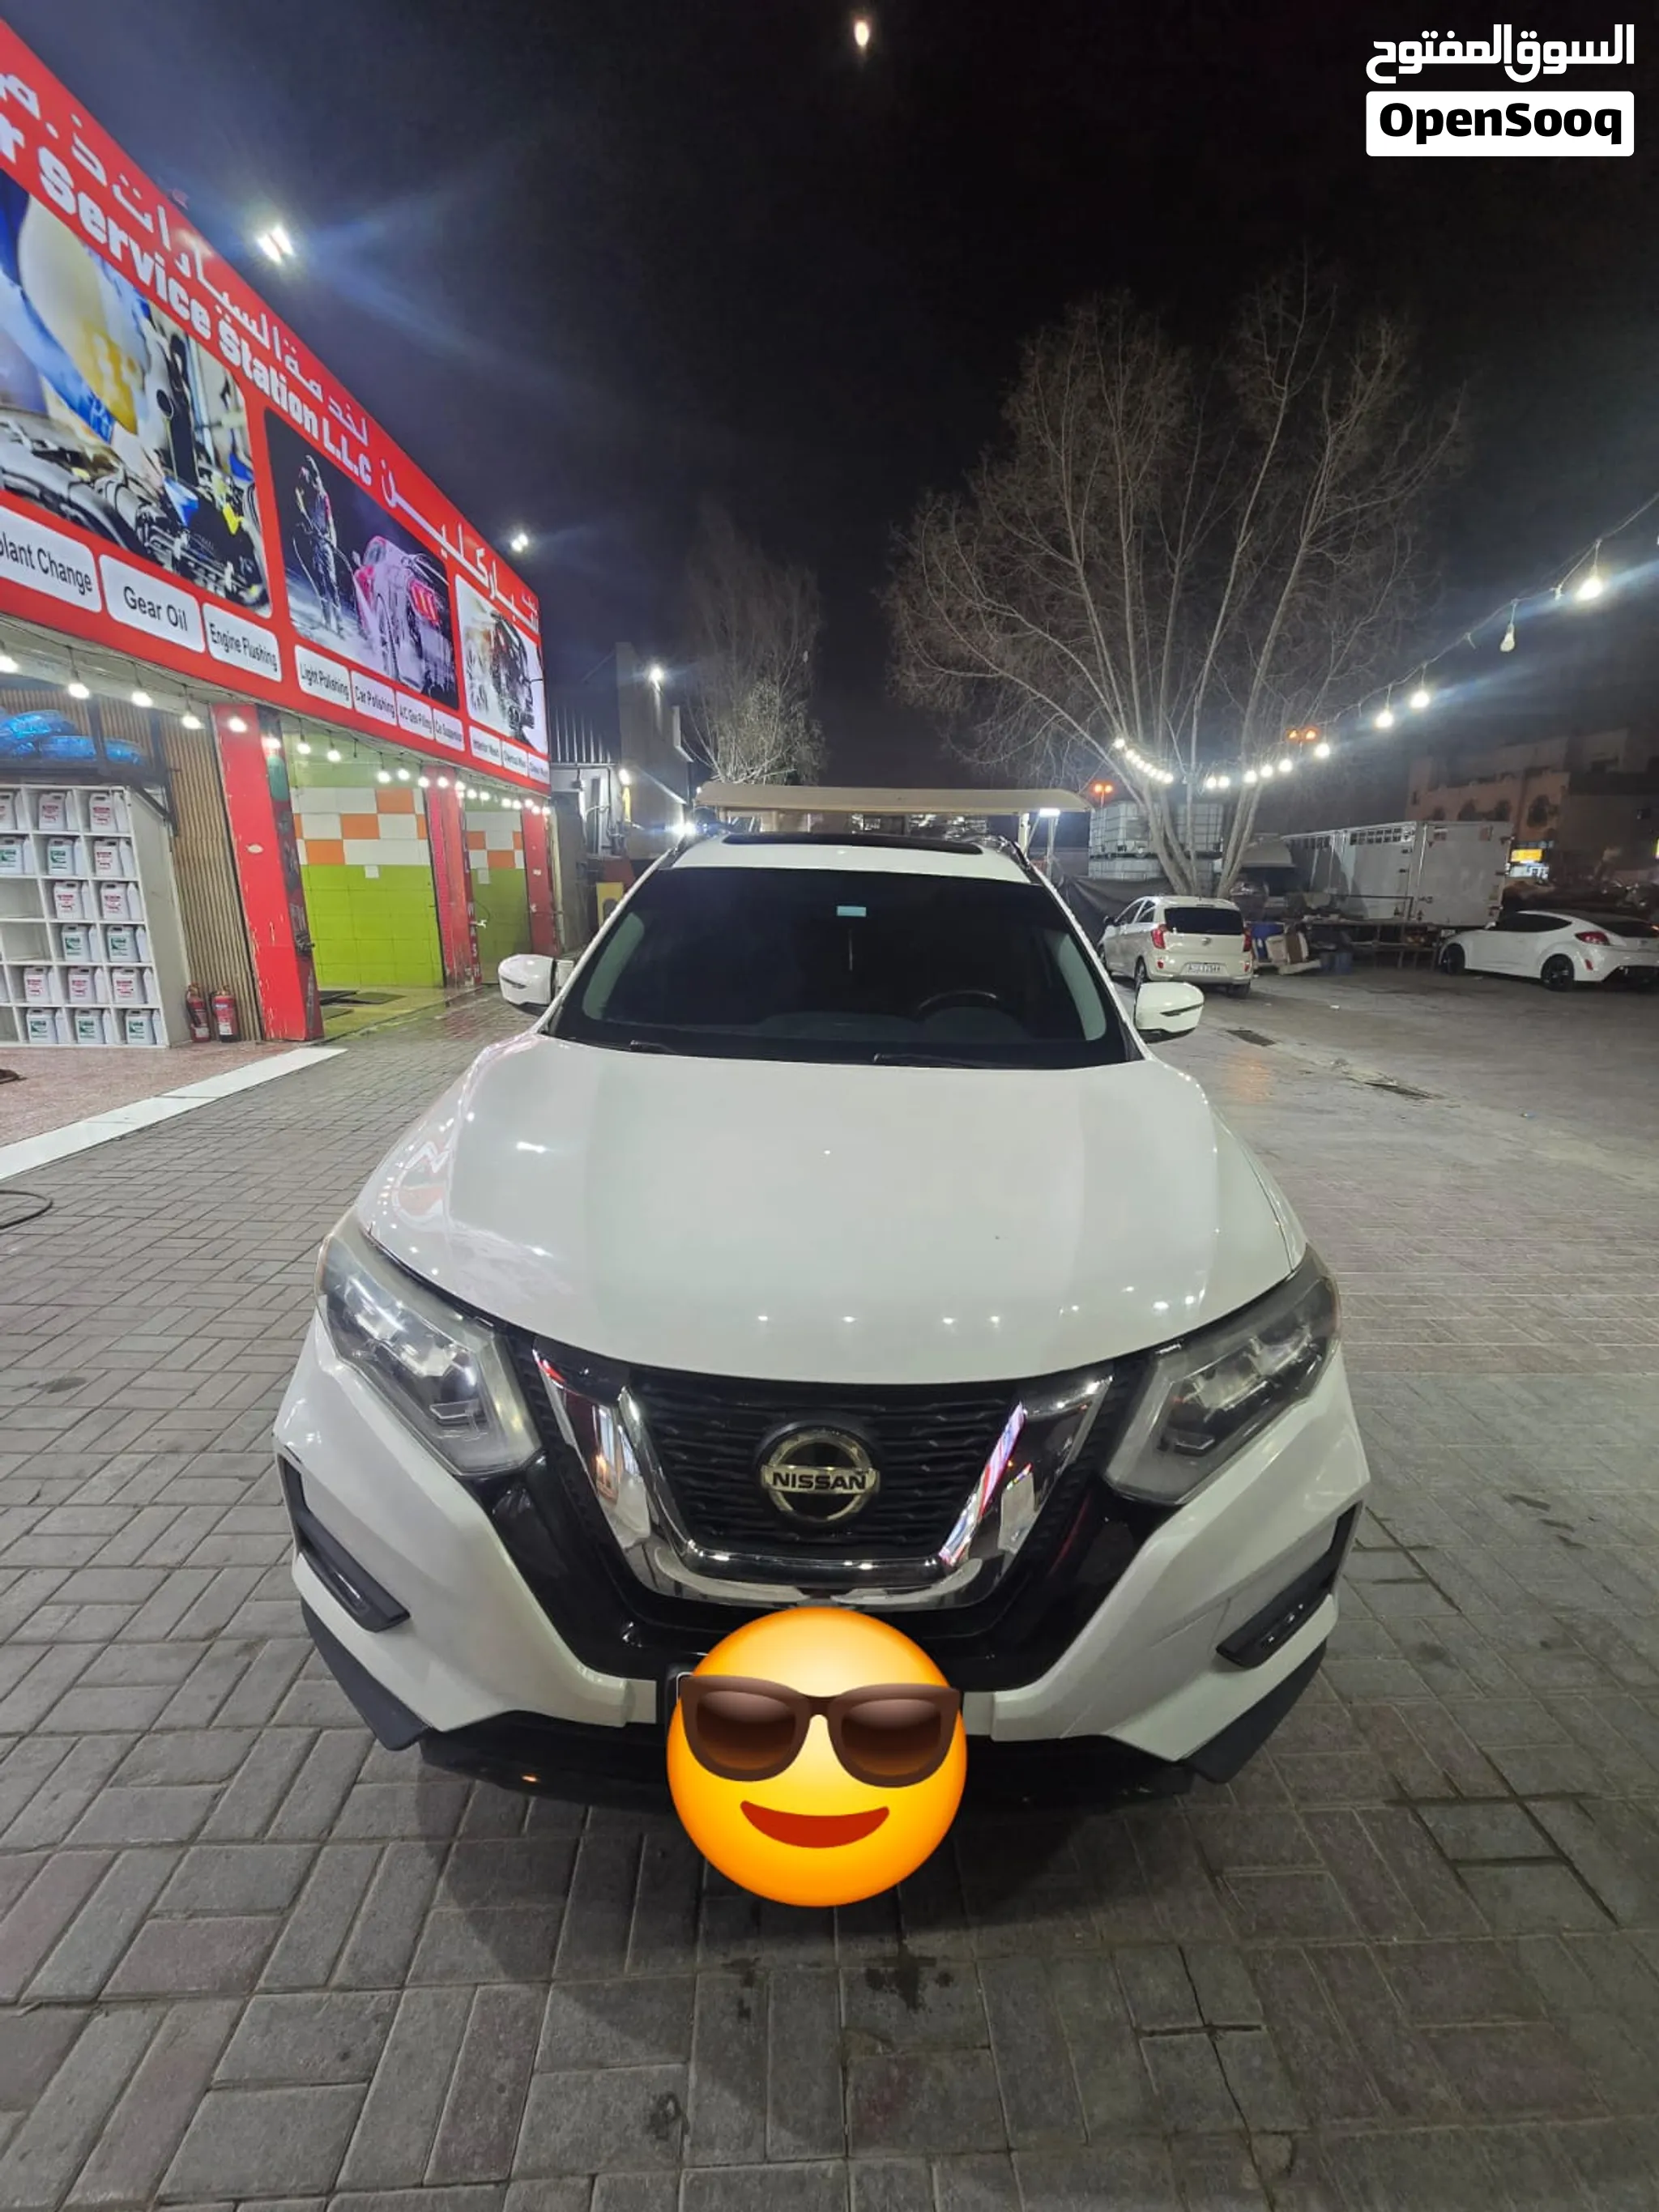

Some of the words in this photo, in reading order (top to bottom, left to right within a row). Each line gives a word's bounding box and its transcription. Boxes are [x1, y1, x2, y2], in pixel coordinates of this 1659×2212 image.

[38, 146, 211, 340] Service
[218, 317, 319, 441] Station
[37, 548, 93, 595] Change
[123, 586, 162, 620] Gear
[166, 603, 188, 631] Oil
[209, 622, 242, 654] Engine
[242, 637, 278, 672] Flushing
[772, 1471, 867, 1490] NISSAN
